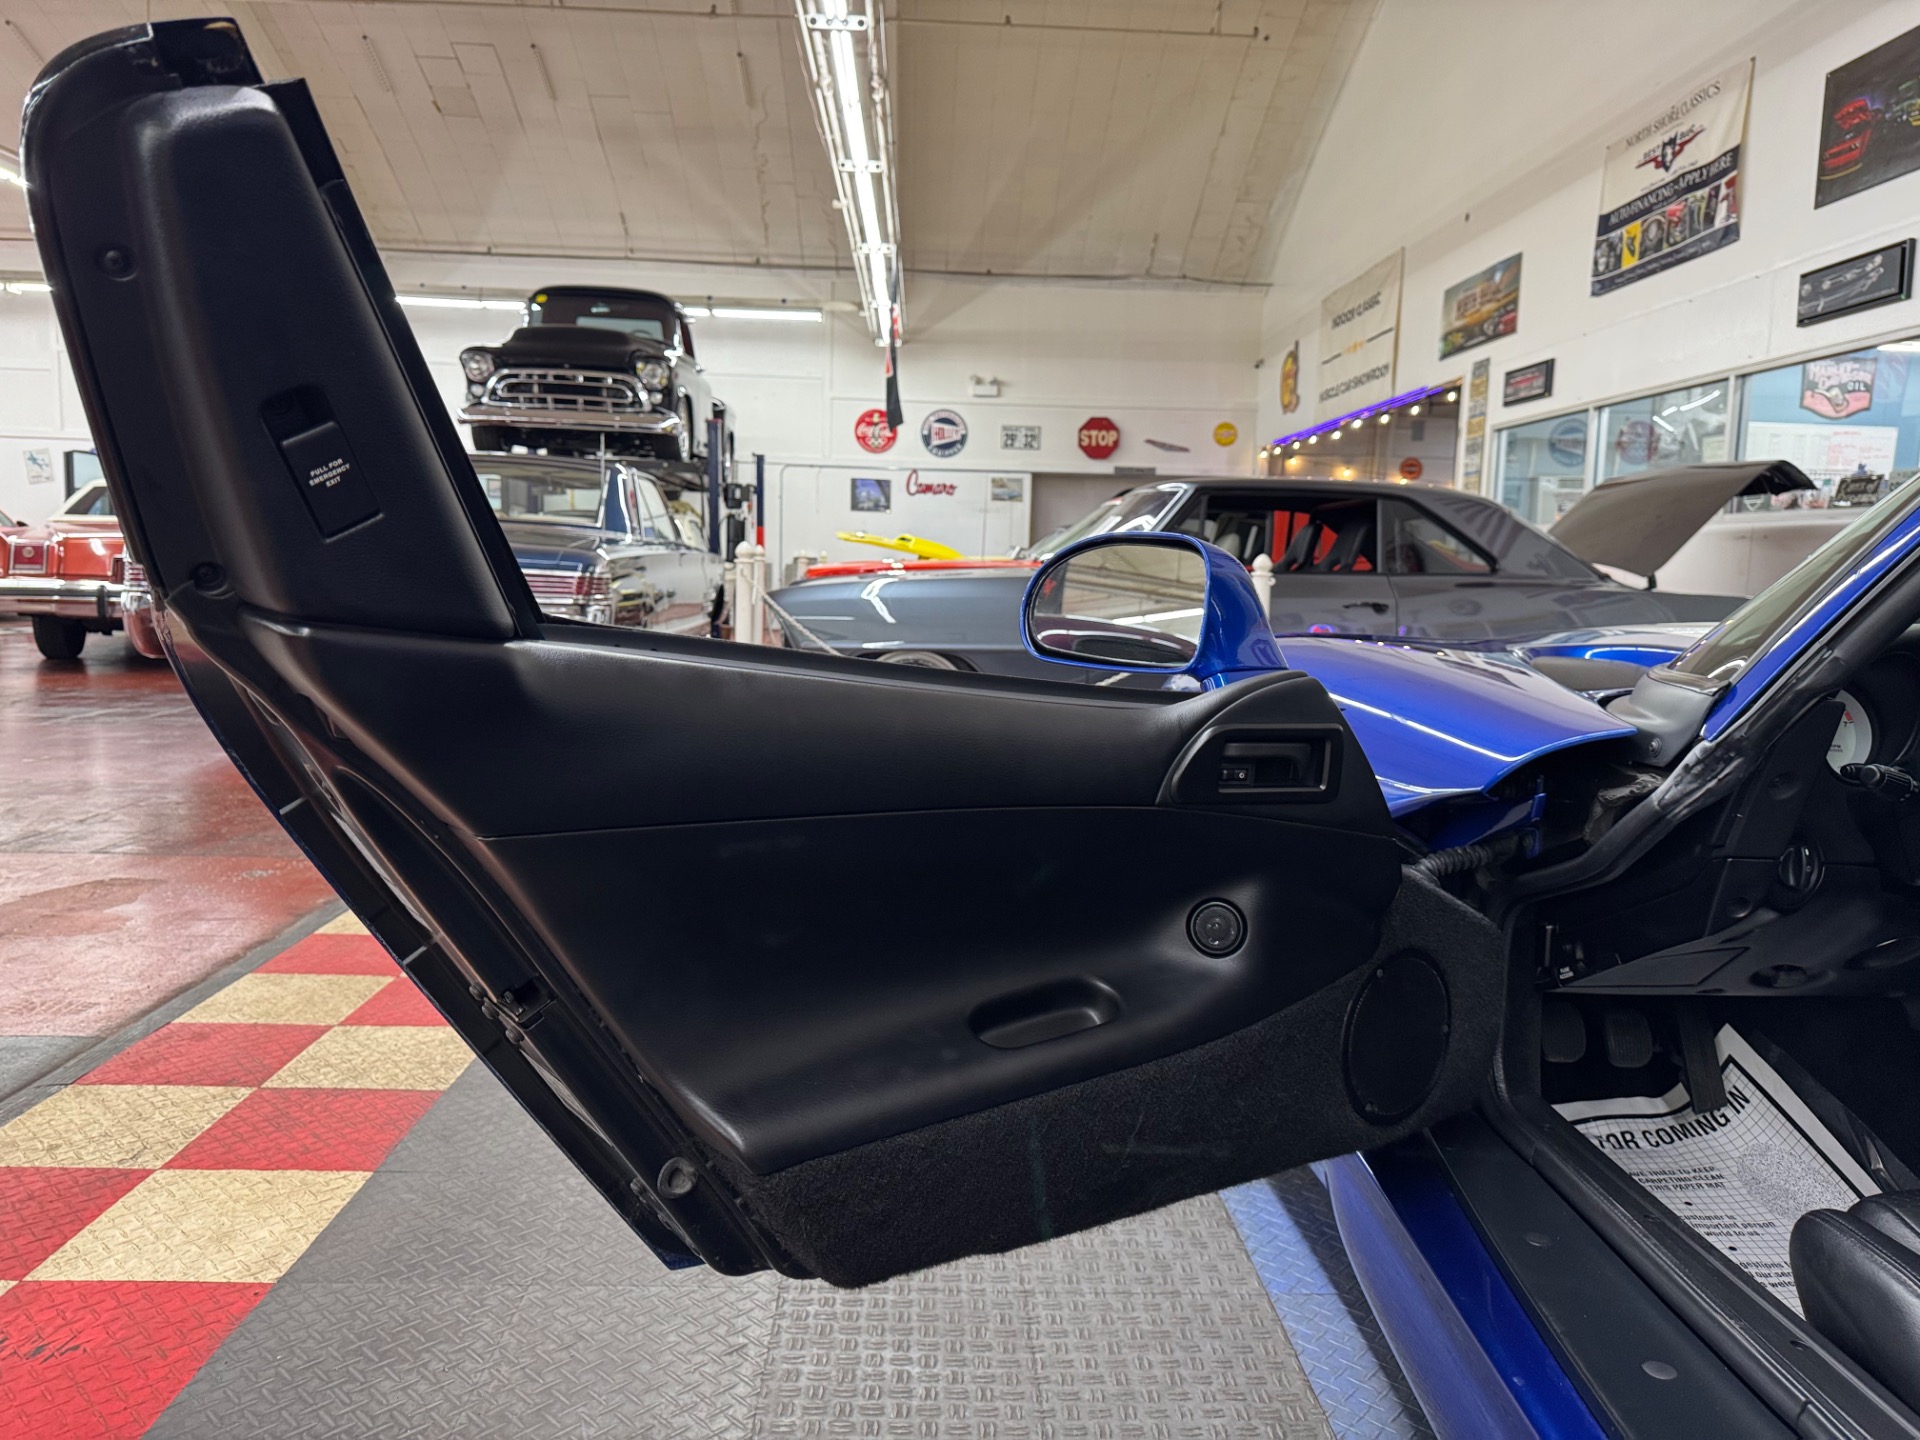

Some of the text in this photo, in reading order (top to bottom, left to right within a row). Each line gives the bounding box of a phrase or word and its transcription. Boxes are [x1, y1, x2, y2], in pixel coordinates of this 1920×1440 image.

[1626, 125, 1653, 146] NORTH
[1680, 80, 1721, 114] CLASSICS
[1708, 152, 1733, 176] HERE
[1847, 381, 1866, 391] OIL
[1080, 429, 1118, 447] STOP
[310, 458, 343, 477] PULL FOR
[309, 463, 350, 486] EMERGENCY
[325, 476, 341, 487] EXIT
[906, 468, 957, 496] Camaro
[1642, 1110, 1731, 1148] COMING
[1727, 1085, 1750, 1115] IN
[1691, 1166, 1715, 1174] KEEP
[1638, 1176, 1692, 1184] CARPETING
[1672, 1183, 1704, 1191] PAPER
[1690, 1221, 1776, 1230] important person
[1704, 1229, 1733, 1237] world
[1740, 1261, 1784, 1270] gestions
[1768, 1280, 1796, 1288] welc
